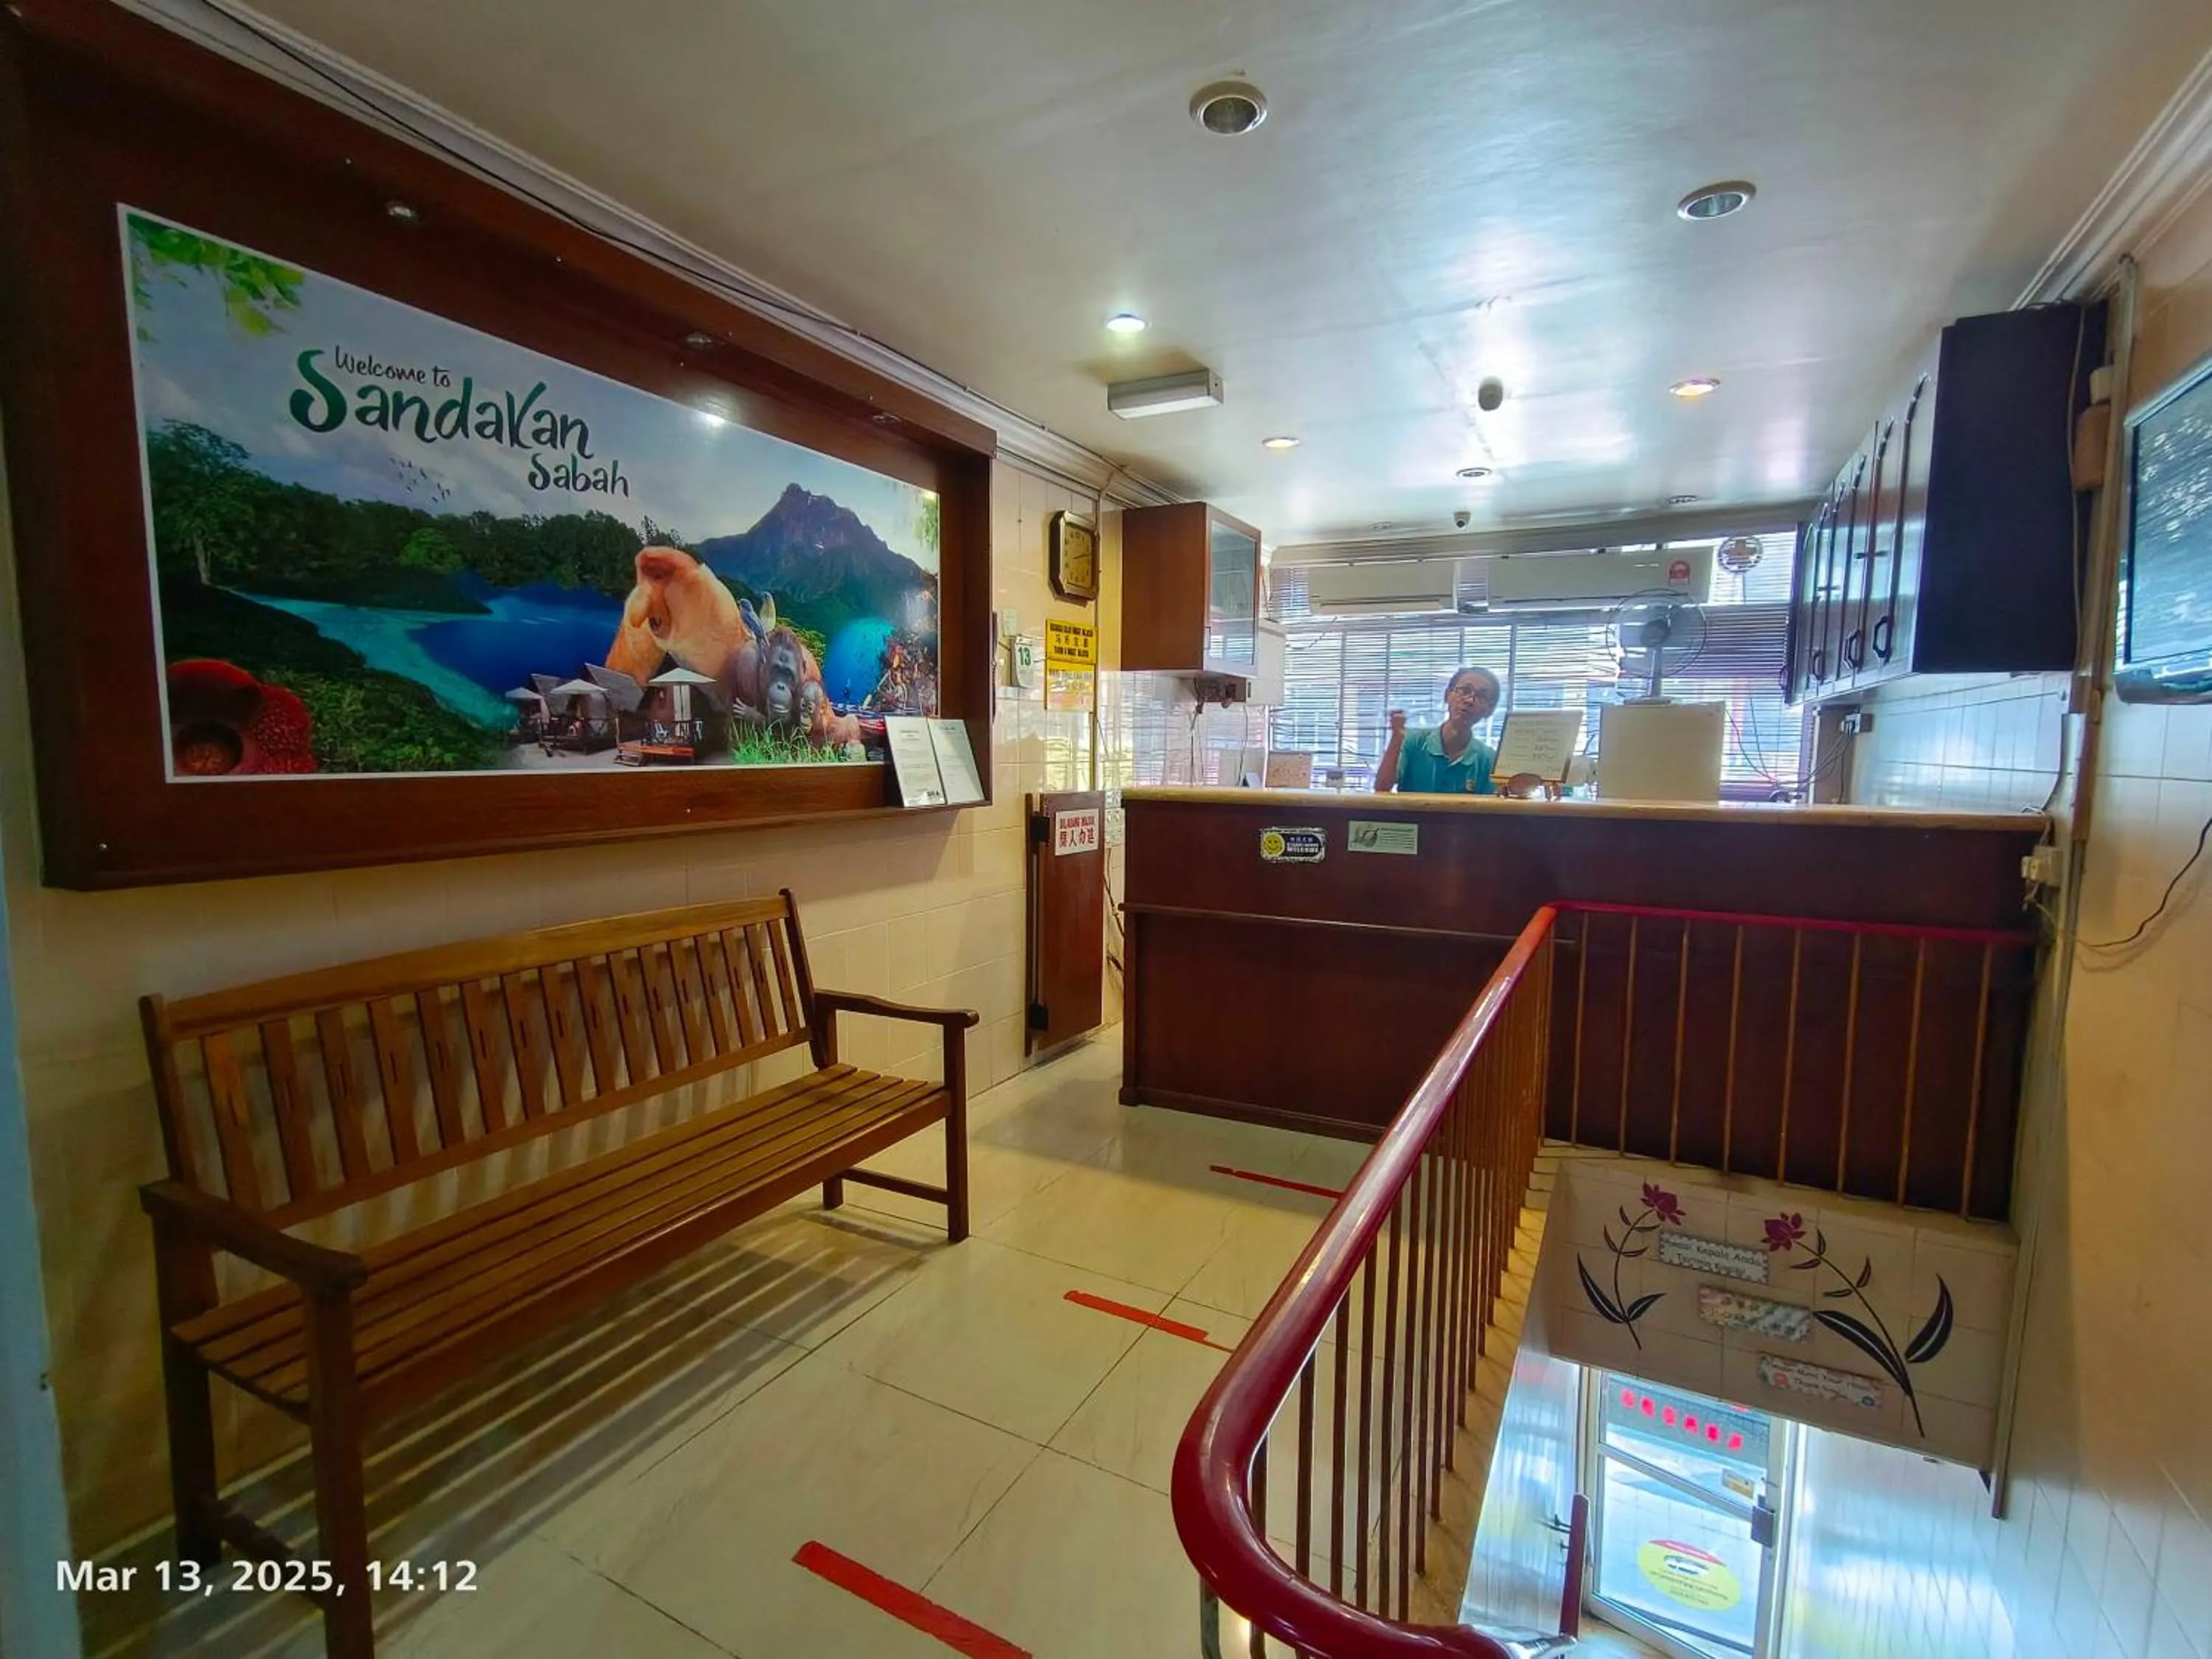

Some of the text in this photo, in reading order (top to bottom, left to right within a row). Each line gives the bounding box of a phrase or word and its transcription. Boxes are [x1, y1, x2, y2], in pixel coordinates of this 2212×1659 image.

[335, 345, 451, 388] Welcome to
[528, 453, 629, 498] Sabah
[1018, 647, 1032, 667] 13
